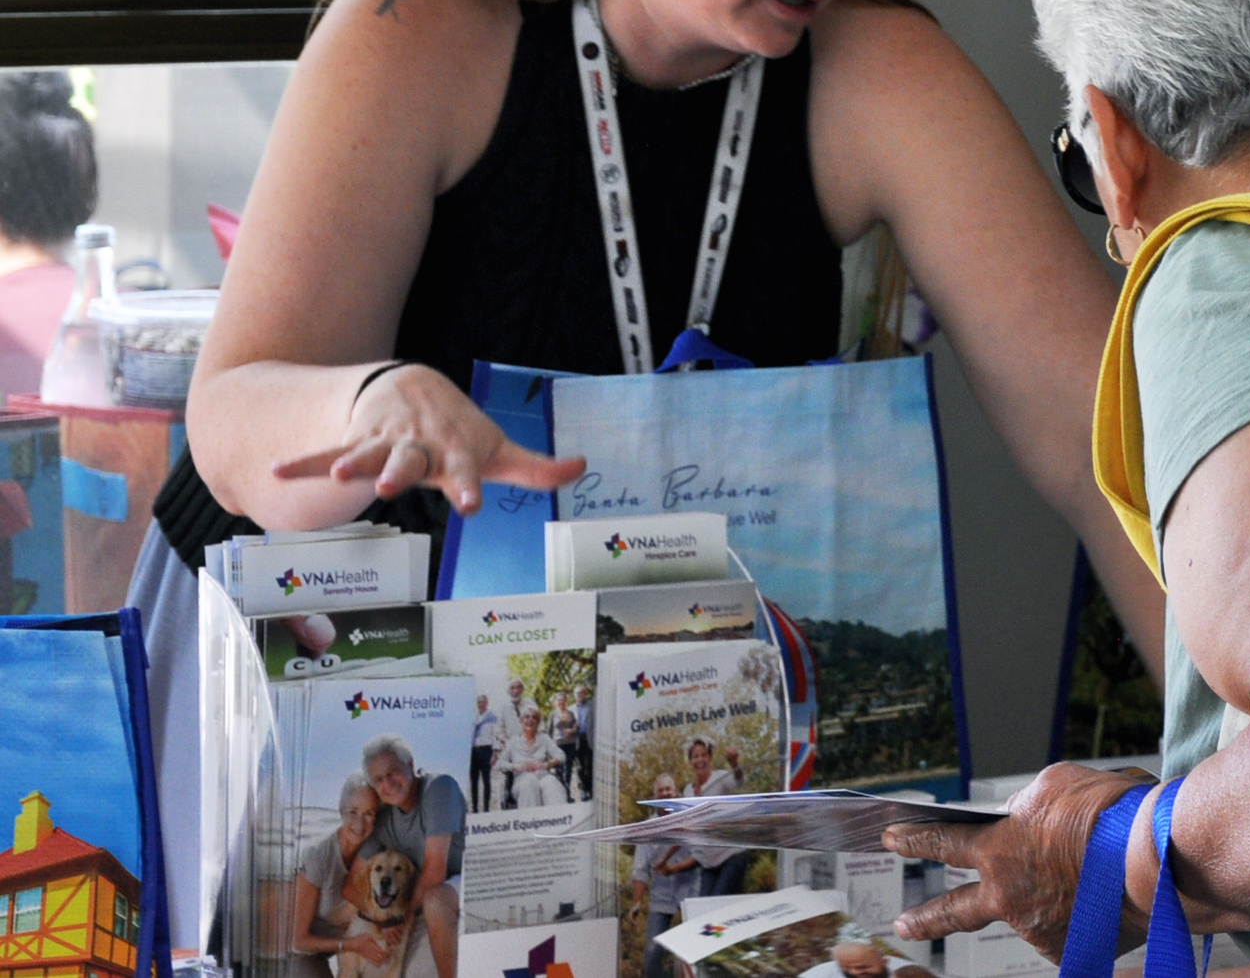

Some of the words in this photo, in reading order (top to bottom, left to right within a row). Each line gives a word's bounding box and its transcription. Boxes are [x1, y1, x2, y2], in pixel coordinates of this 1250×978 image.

[662, 464, 778, 509] Barbara
[727, 513, 745, 526] ive
[627, 534, 697, 550] VNAHealth
[645, 550, 675, 561] Hospice
[678, 548, 697, 559] Care
[302, 568, 379, 586] VNAHealth
[323, 586, 354, 597] Serenity
[355, 584, 379, 594] House
[497, 610, 545, 622] VNAHealth
[468, 633, 503, 647] LOAN
[507, 628, 557, 643] CLOSET
[293, 660, 307, 671] C
[320, 657, 334, 669] U
[652, 665, 718, 687] VNAHealth
[679, 683, 700, 694] Health
[702, 682, 718, 691] Care
[370, 694, 445, 711] VNAHealth
[411, 710, 427, 720] Live
[428, 709, 444, 719] Well
[630, 717, 655, 734] Get
[656, 711, 684, 729] Well
[686, 711, 699, 724] to
[701, 706, 727, 722] Live
[729, 699, 756, 717] Well
[471, 820, 511, 835] Medical
[513, 813, 573, 831] Equipment?
